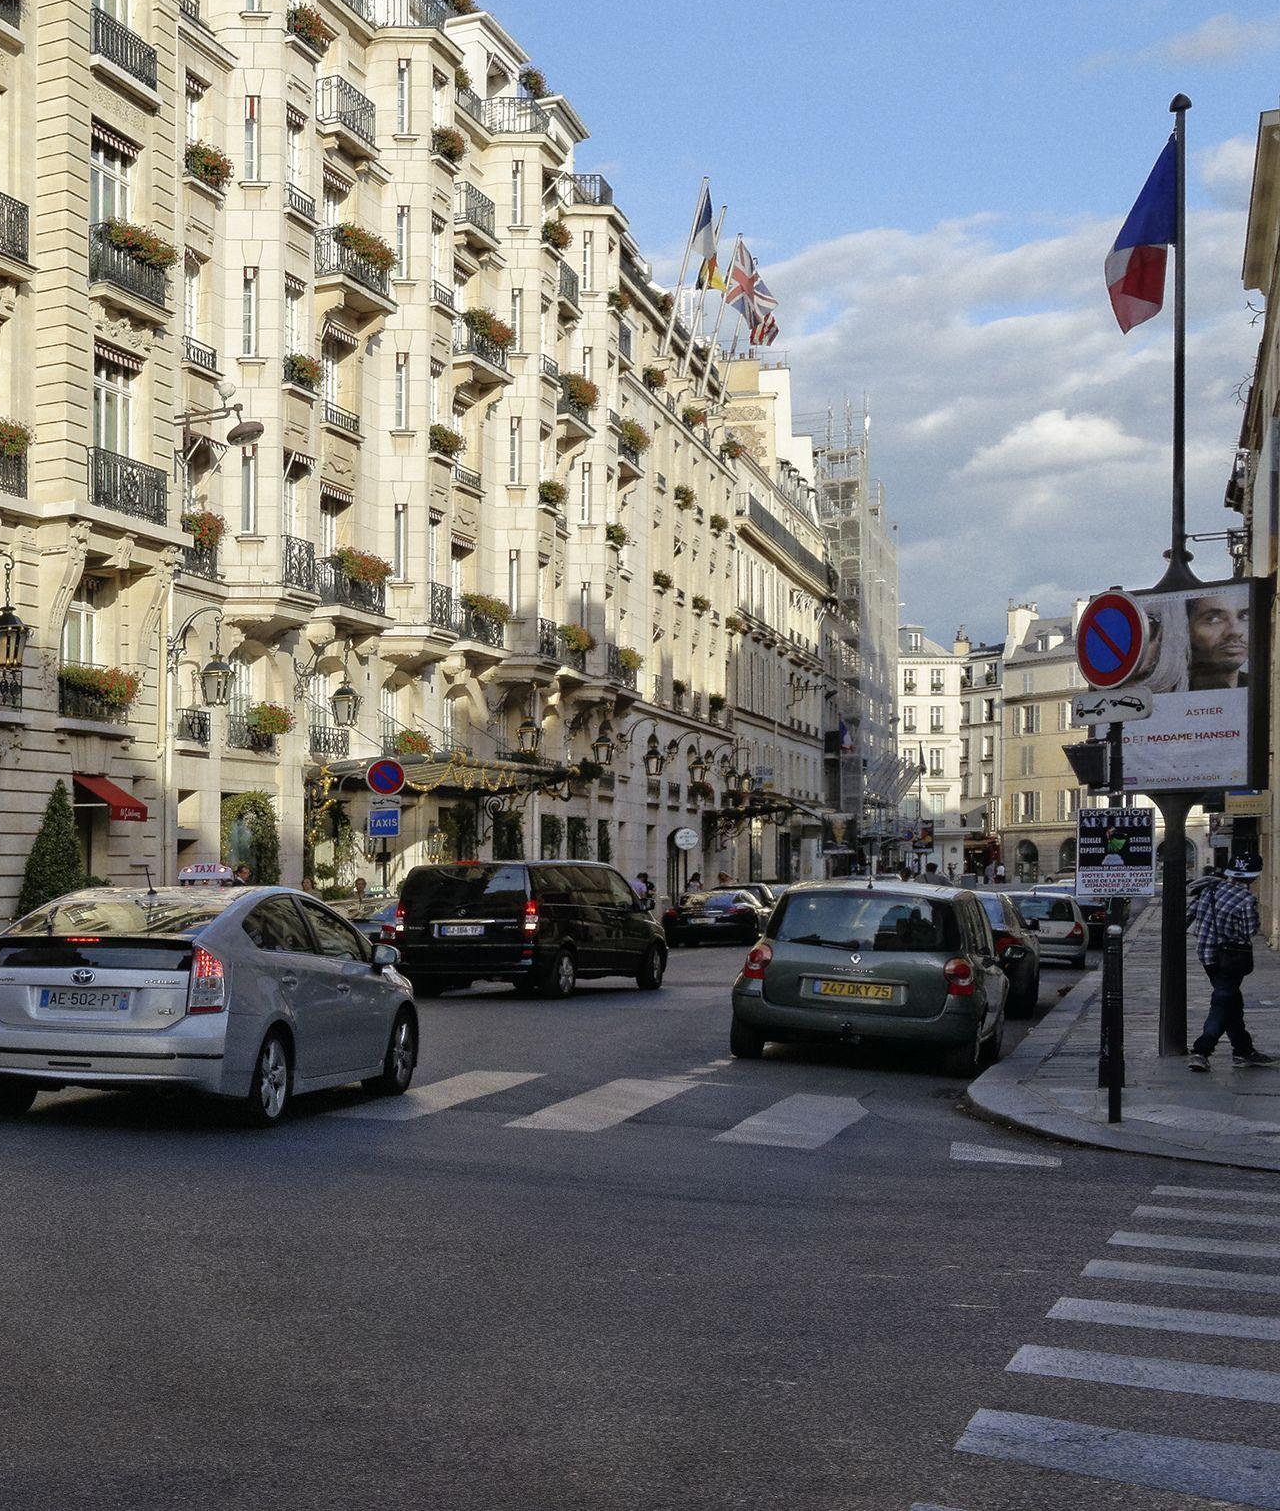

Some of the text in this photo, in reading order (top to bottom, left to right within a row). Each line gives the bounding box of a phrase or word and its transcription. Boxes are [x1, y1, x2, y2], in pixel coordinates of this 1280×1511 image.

[1186, 707, 1223, 716] ASTIER
[1133, 736, 1144, 744] ET
[1147, 733, 1192, 742] MADAME
[1195, 730, 1240, 740] HANSEN
[1082, 809, 1150, 817] EXPOSITION
[371, 818, 398, 828] TAXIS
[1081, 816, 1152, 828] ART DECO
[194, 864, 216, 873] TAXI
[1235, 859, 1249, 870] NY
[822, 982, 846, 994] 747
[874, 986, 889, 997] 75
